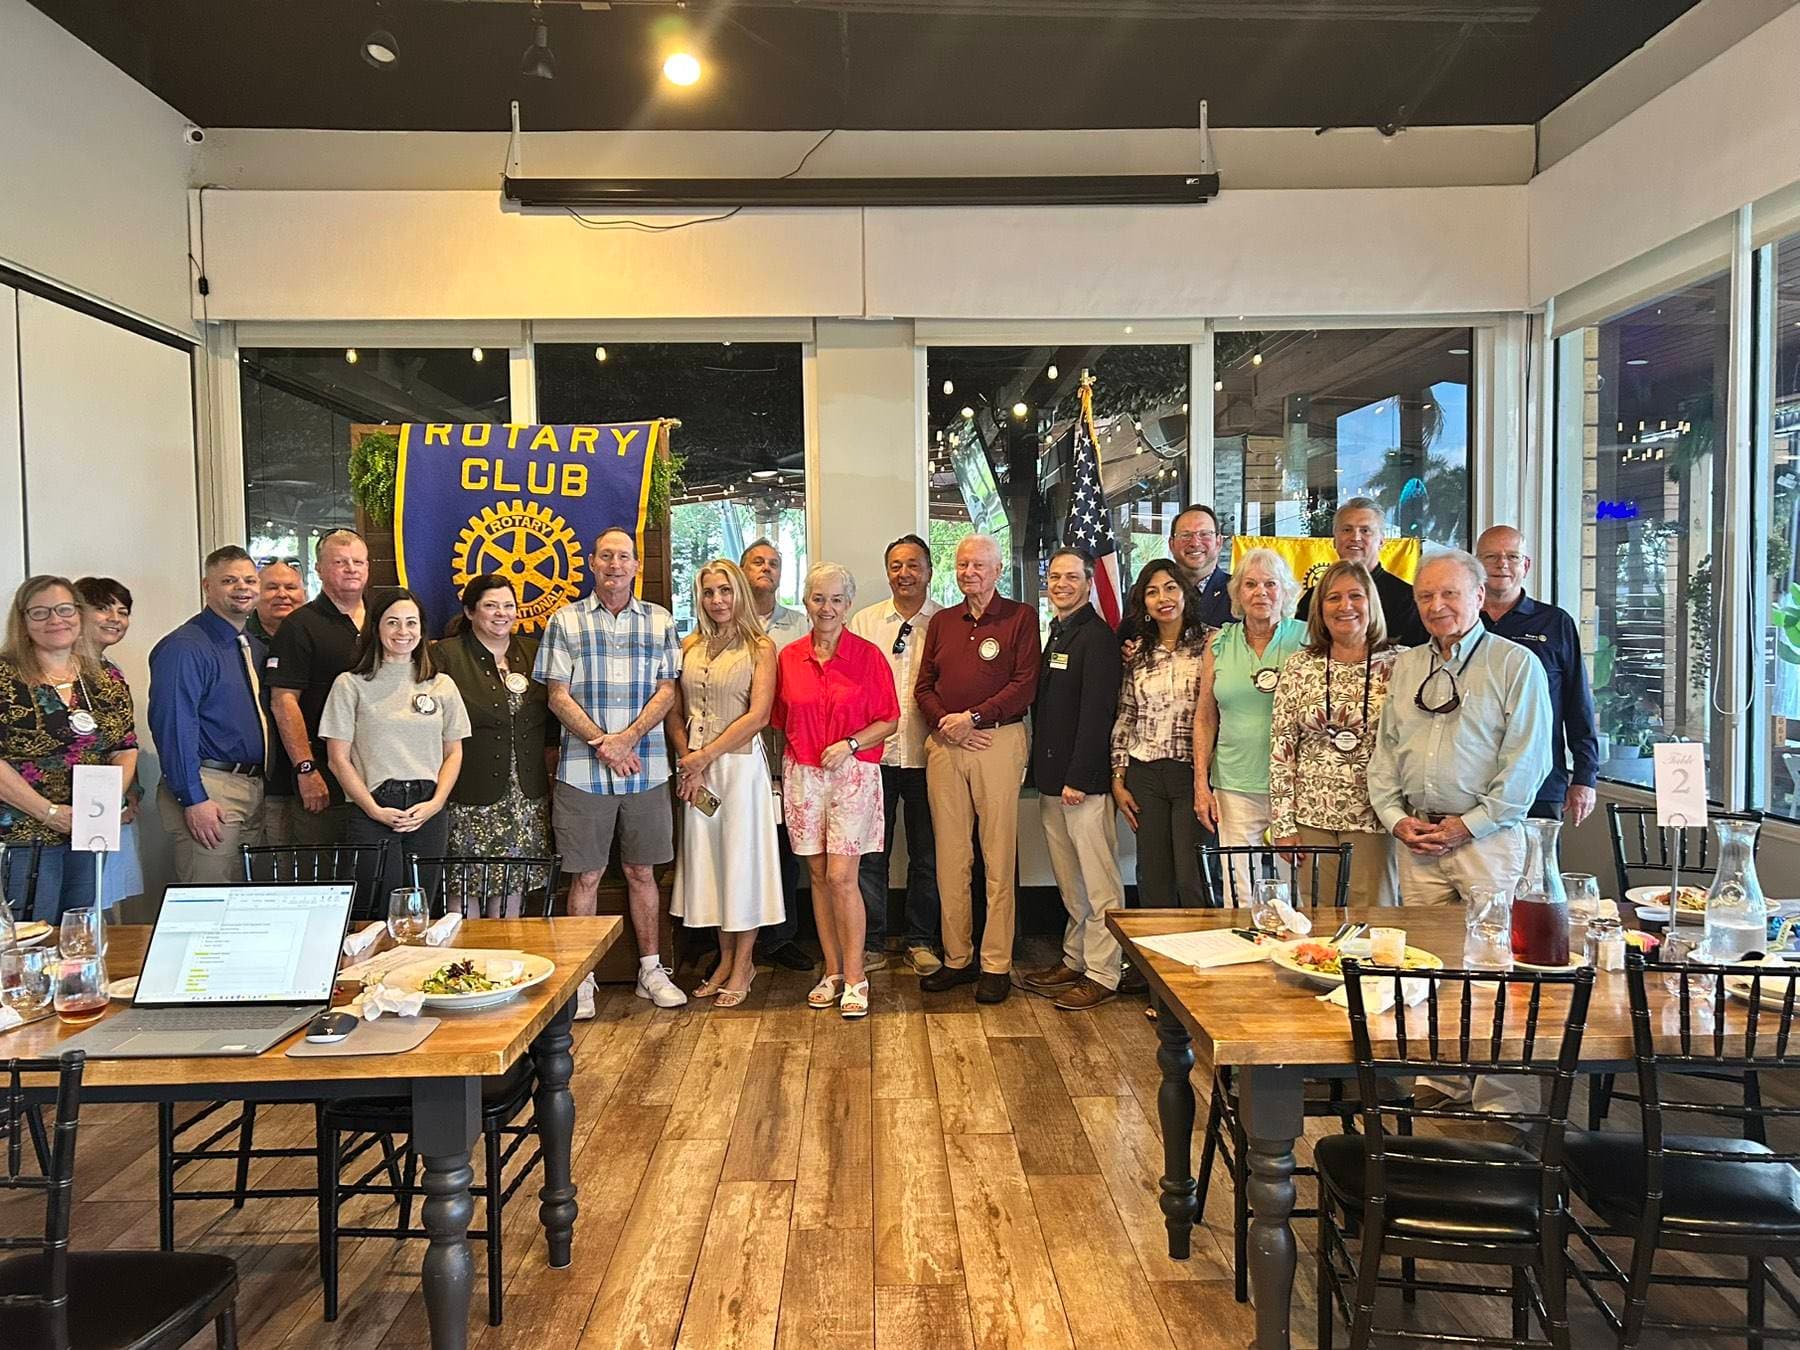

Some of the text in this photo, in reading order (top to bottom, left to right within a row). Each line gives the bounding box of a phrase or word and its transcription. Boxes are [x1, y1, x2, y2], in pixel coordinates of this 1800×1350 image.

[424, 422, 640, 457] ROTARY
[460, 457, 589, 498] CLUB
[489, 515, 552, 535] ROTARY
[1671, 768, 1691, 794] 2
